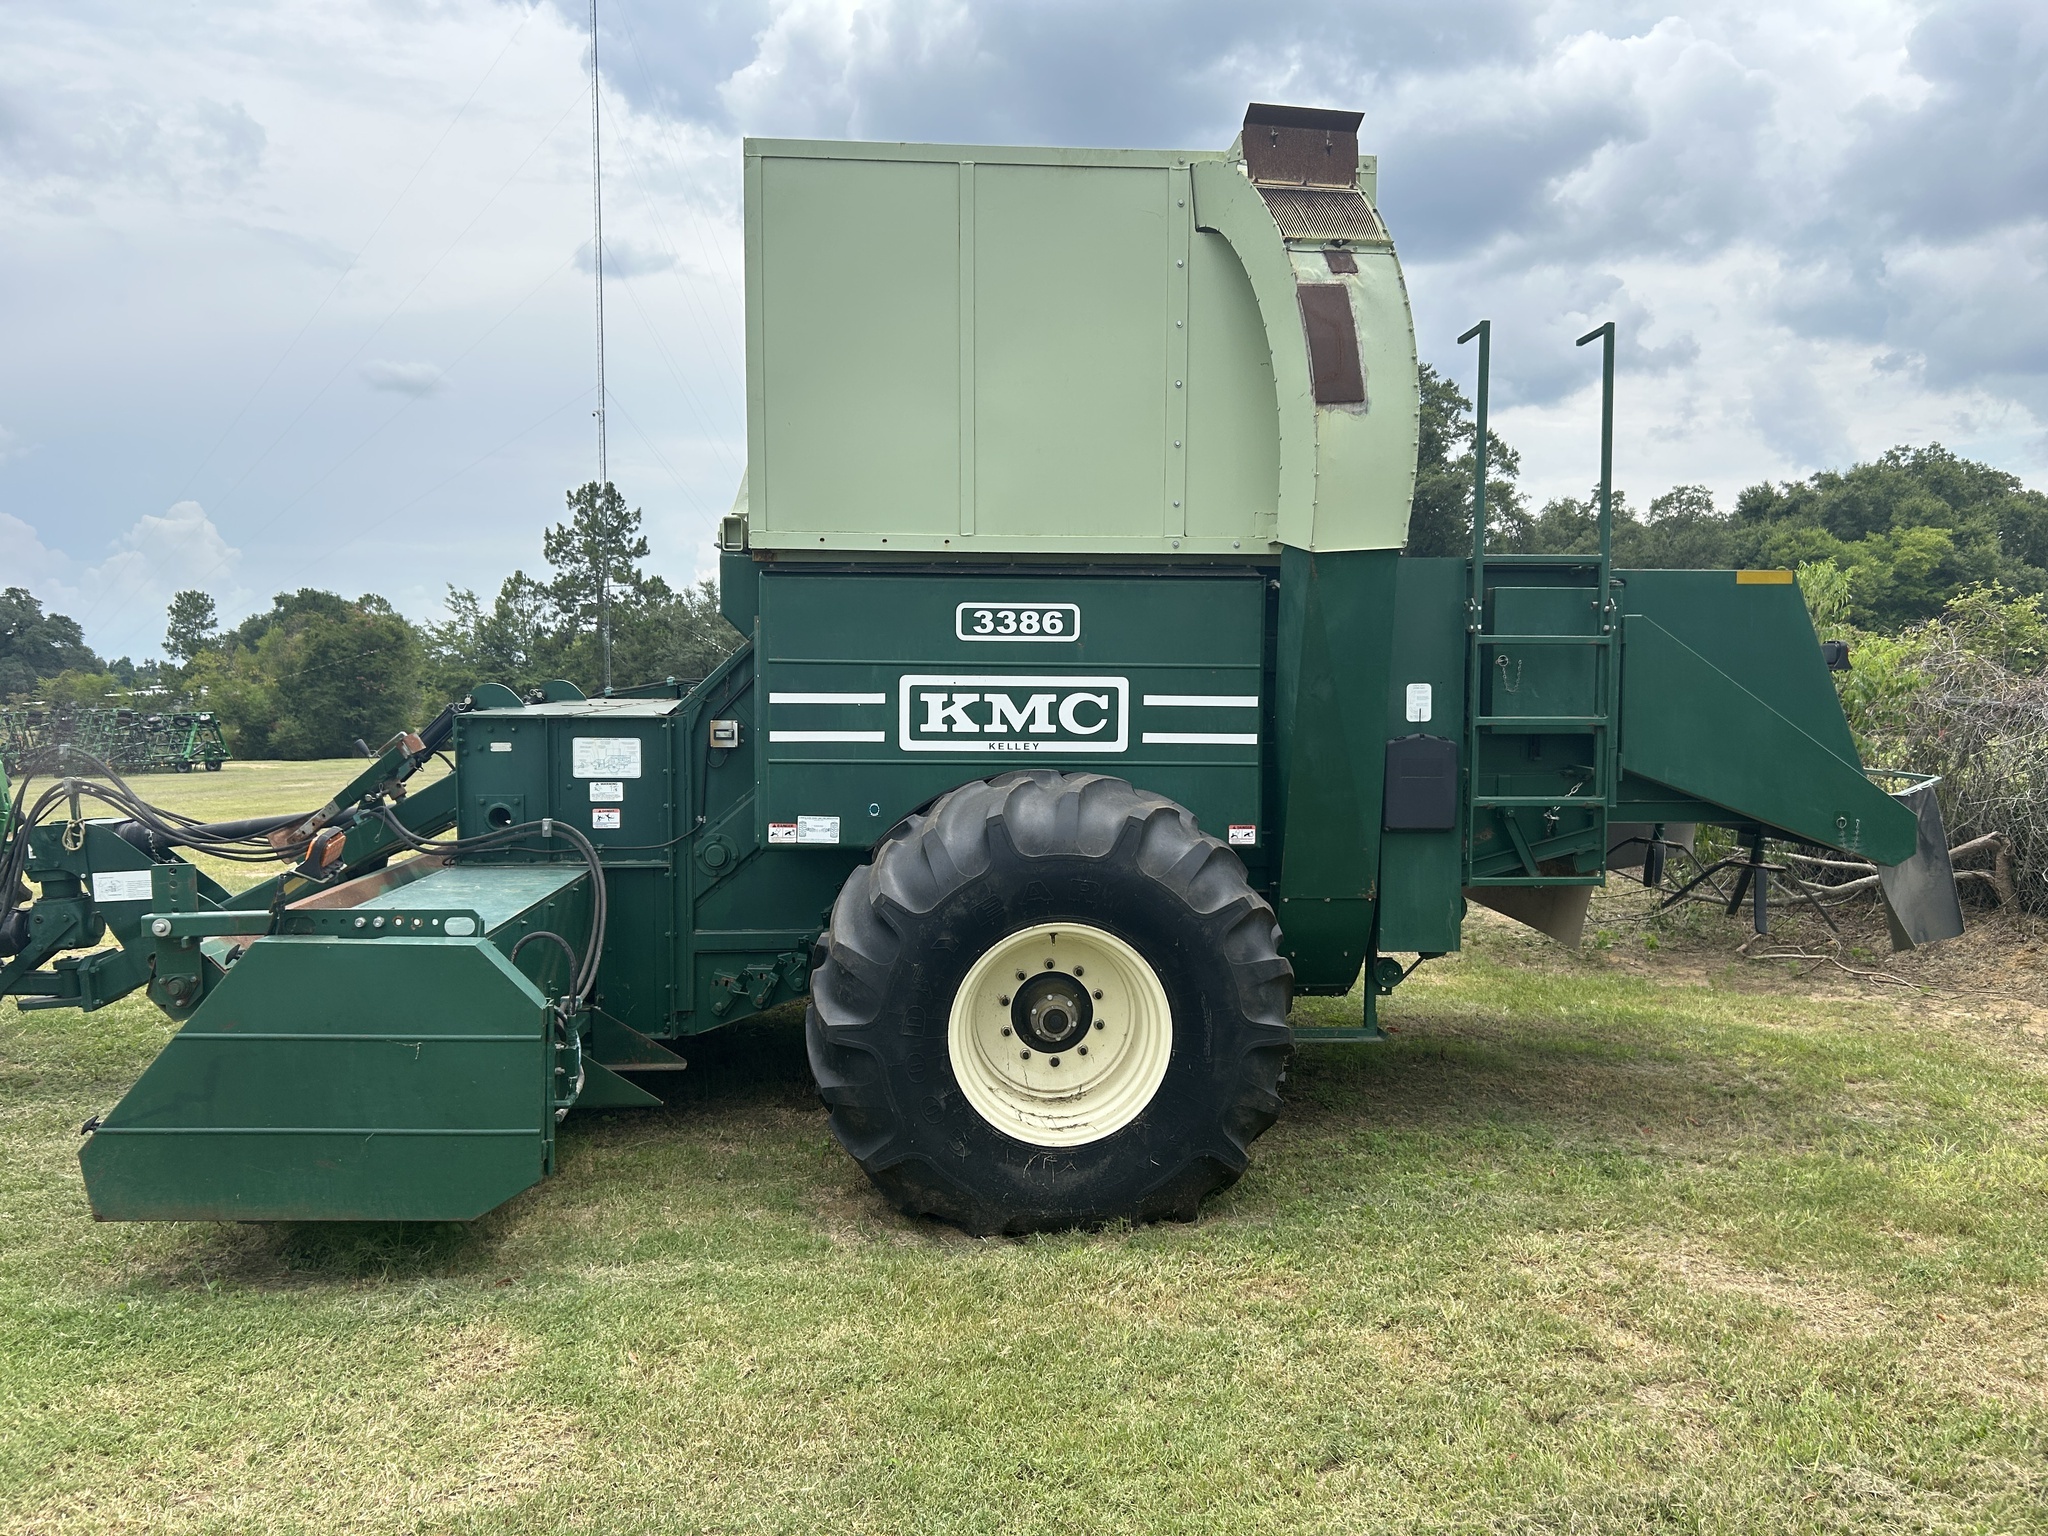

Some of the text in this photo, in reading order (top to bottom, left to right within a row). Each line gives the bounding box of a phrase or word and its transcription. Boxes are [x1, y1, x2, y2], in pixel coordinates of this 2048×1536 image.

[972, 609, 1064, 634] 3386
[919, 692, 1109, 735] KMC
[988, 742, 1040, 751] KELLEY
